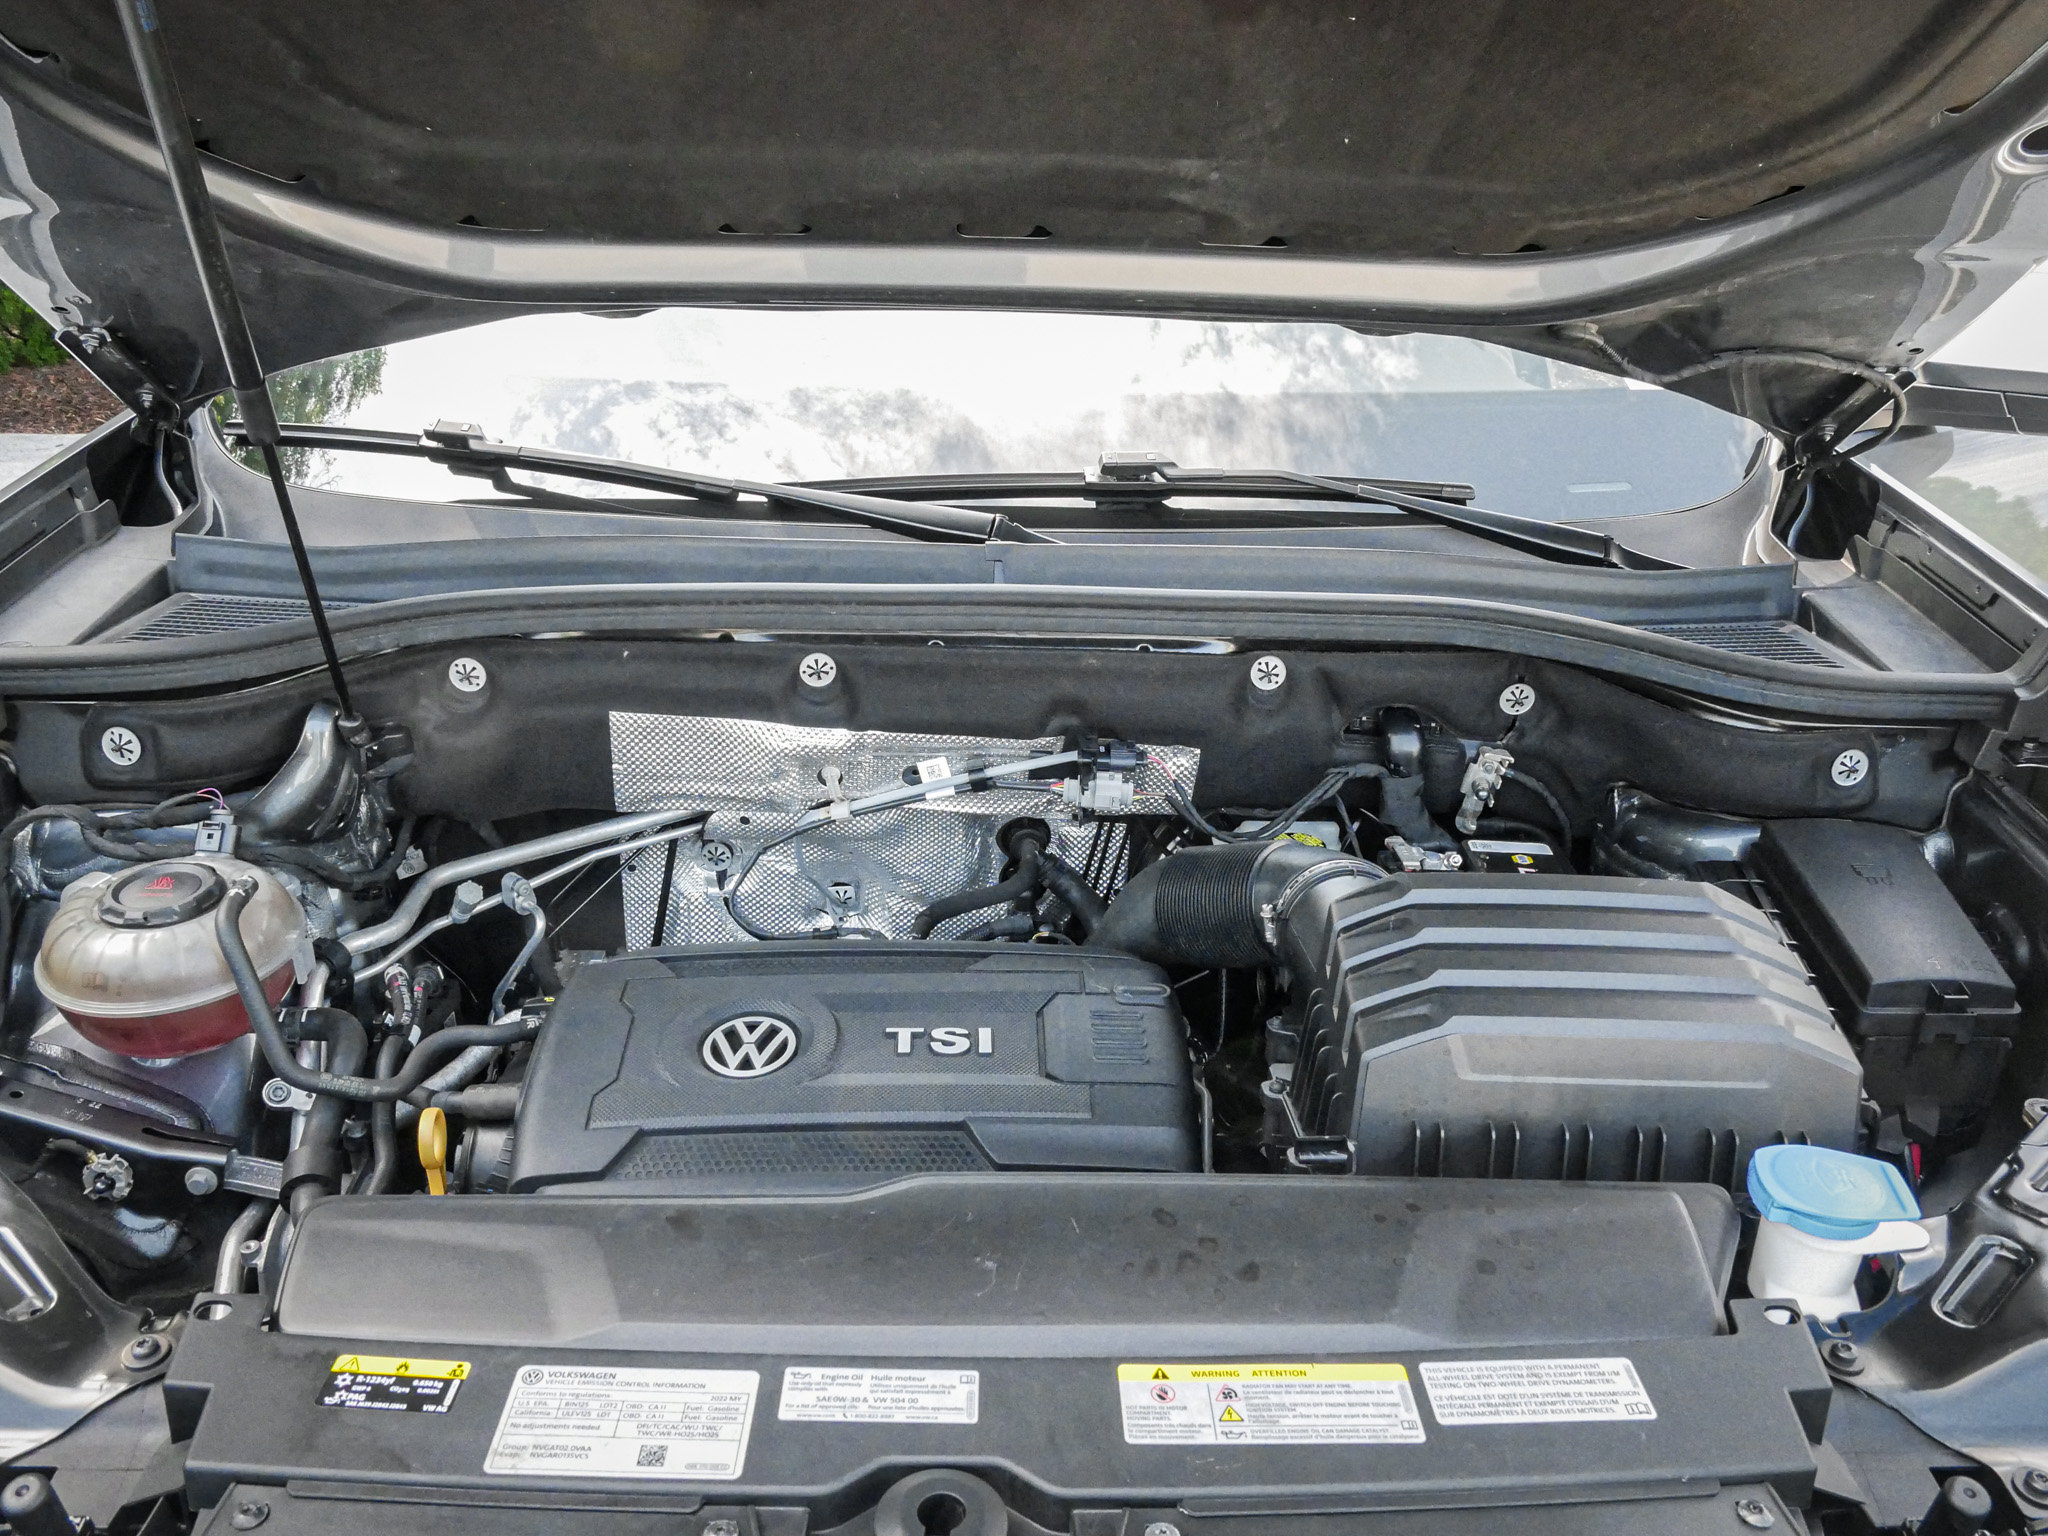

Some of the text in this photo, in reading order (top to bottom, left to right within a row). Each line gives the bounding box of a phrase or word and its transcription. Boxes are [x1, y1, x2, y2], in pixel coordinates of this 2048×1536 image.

[885, 1026, 994, 1055] TSI
[702, 1015, 797, 1078] VW
[548, 1371, 617, 1380] VOLKSWAGEN
[821, 1373, 849, 1382] Engine
[1191, 1370, 1240, 1378] WARNING
[356, 1374, 397, 1386] R-1234yf
[432, 1380, 444, 1388] kg
[346, 1393, 366, 1401] PAG
[435, 1405, 448, 1413] AG
